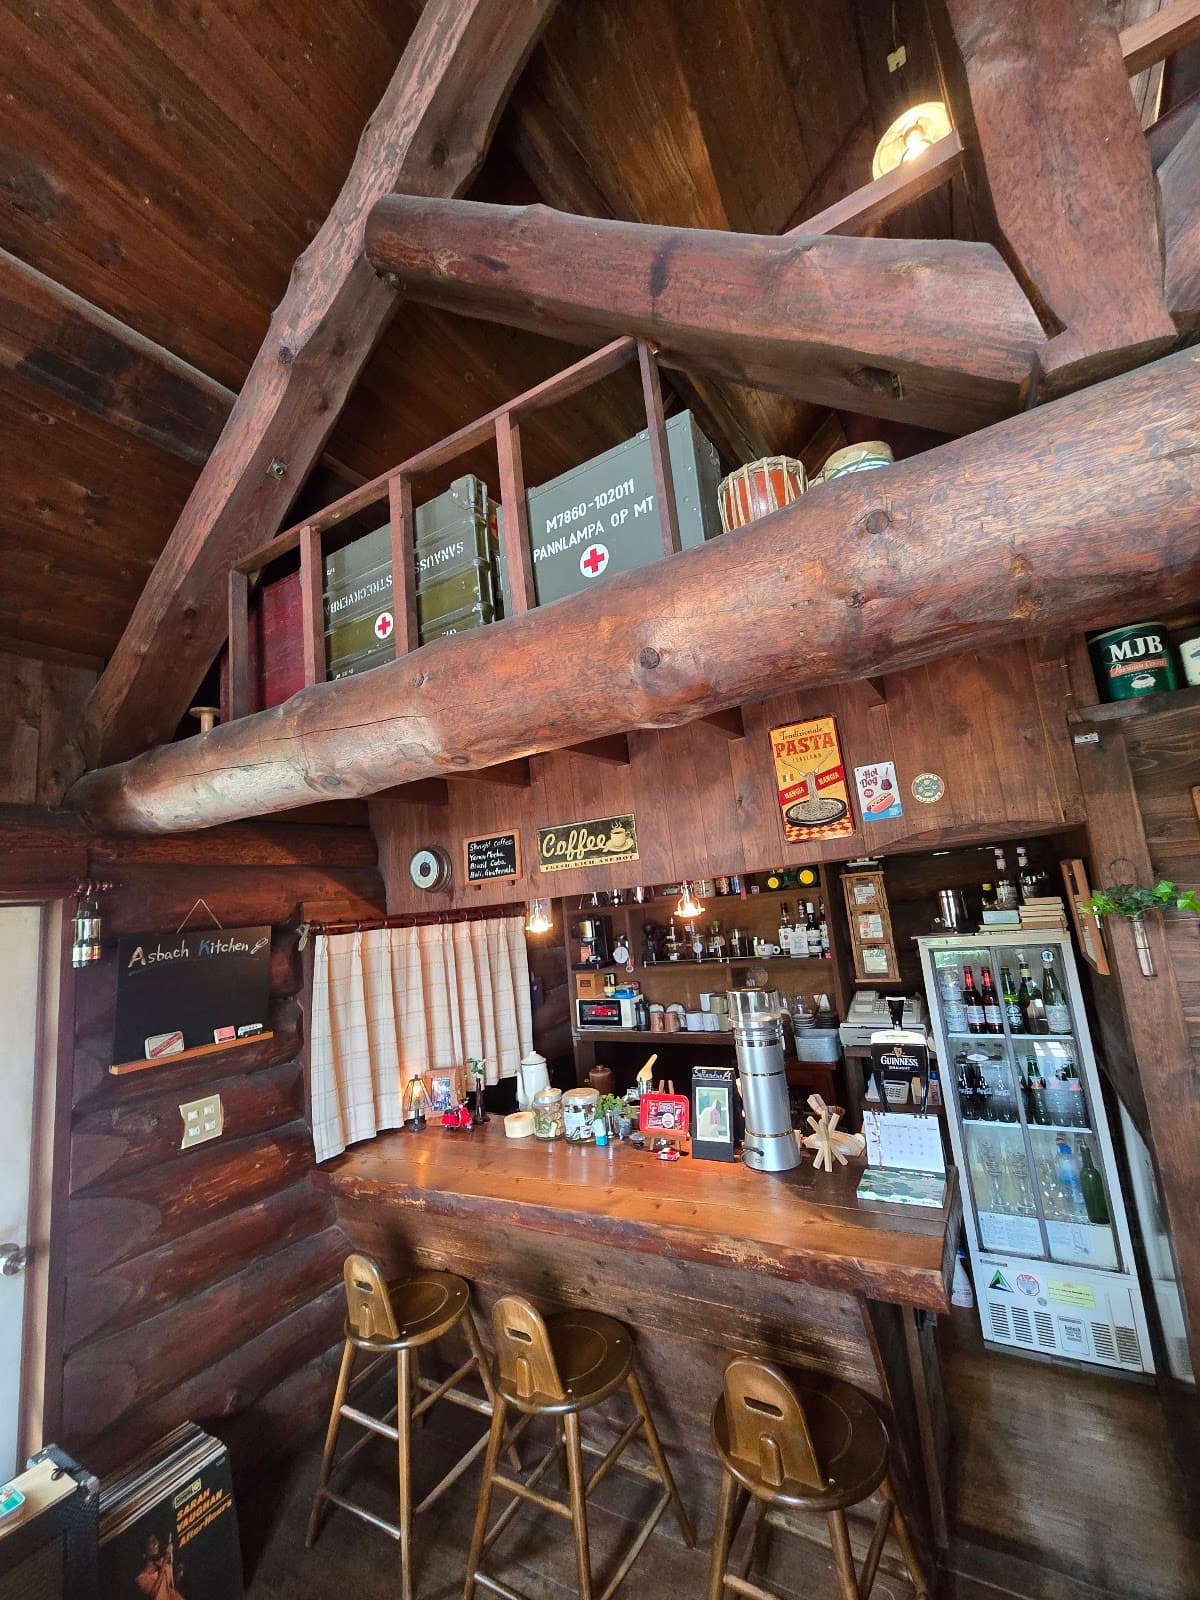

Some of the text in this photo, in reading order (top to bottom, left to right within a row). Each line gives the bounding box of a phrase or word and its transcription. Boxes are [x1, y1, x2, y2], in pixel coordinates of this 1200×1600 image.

[546, 478, 635, 534] M7860-102011
[533, 495, 654, 563] PANNLAMPA OP MT
[1109, 635, 1163, 662] MJB
[774, 732, 836, 758] PASTA
[860, 776, 879, 788] Dog
[863, 767, 879, 779] Hot
[493, 838, 513, 848] Coffee
[542, 828, 609, 861] Coffee
[128, 937, 249, 968] Asbach Kitchen
[176, 1488, 210, 1522] SARAH
[176, 1489, 223, 1533] VAUGHAN
